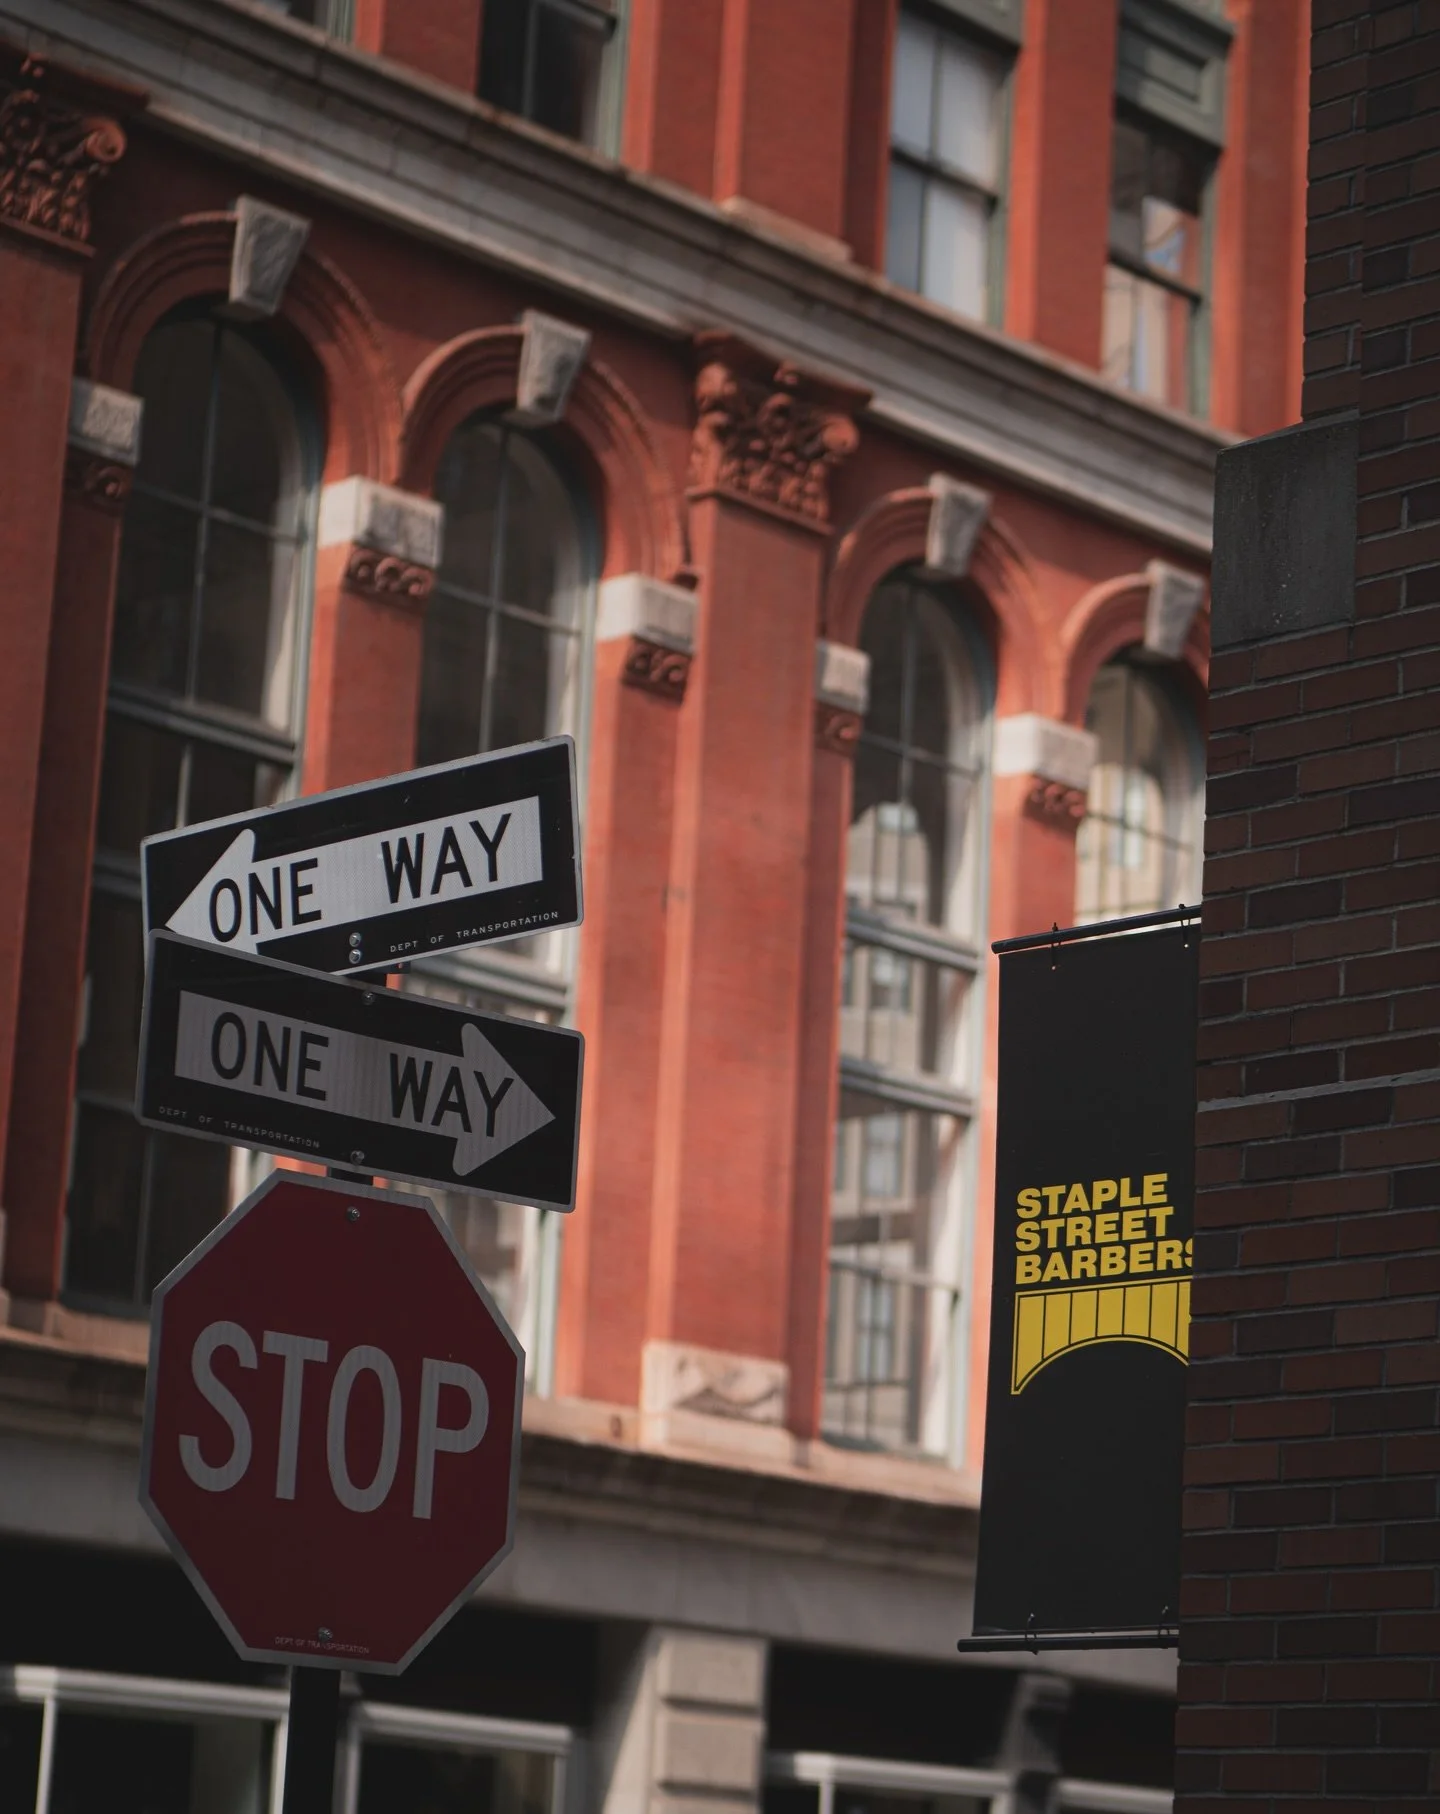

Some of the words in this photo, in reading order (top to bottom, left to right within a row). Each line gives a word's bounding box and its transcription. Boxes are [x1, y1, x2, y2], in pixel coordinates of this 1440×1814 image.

[209, 857, 322, 943] ONE
[381, 813, 511, 904] WAY
[389, 940, 418, 953] DEPT
[430, 934, 445, 944] OF
[456, 911, 559, 939] TRANSPORTATION
[211, 1011, 329, 1101] ONE
[390, 1053, 514, 1138] WAY
[158, 1106, 188, 1119] DEPT
[198, 1114, 214, 1124] OF
[224, 1120, 320, 1149] TRANSPORTATION
[1016, 1172, 1169, 1219] STAPLE
[1015, 1206, 1174, 1252] STREET
[178, 1320, 489, 1520] STOP
